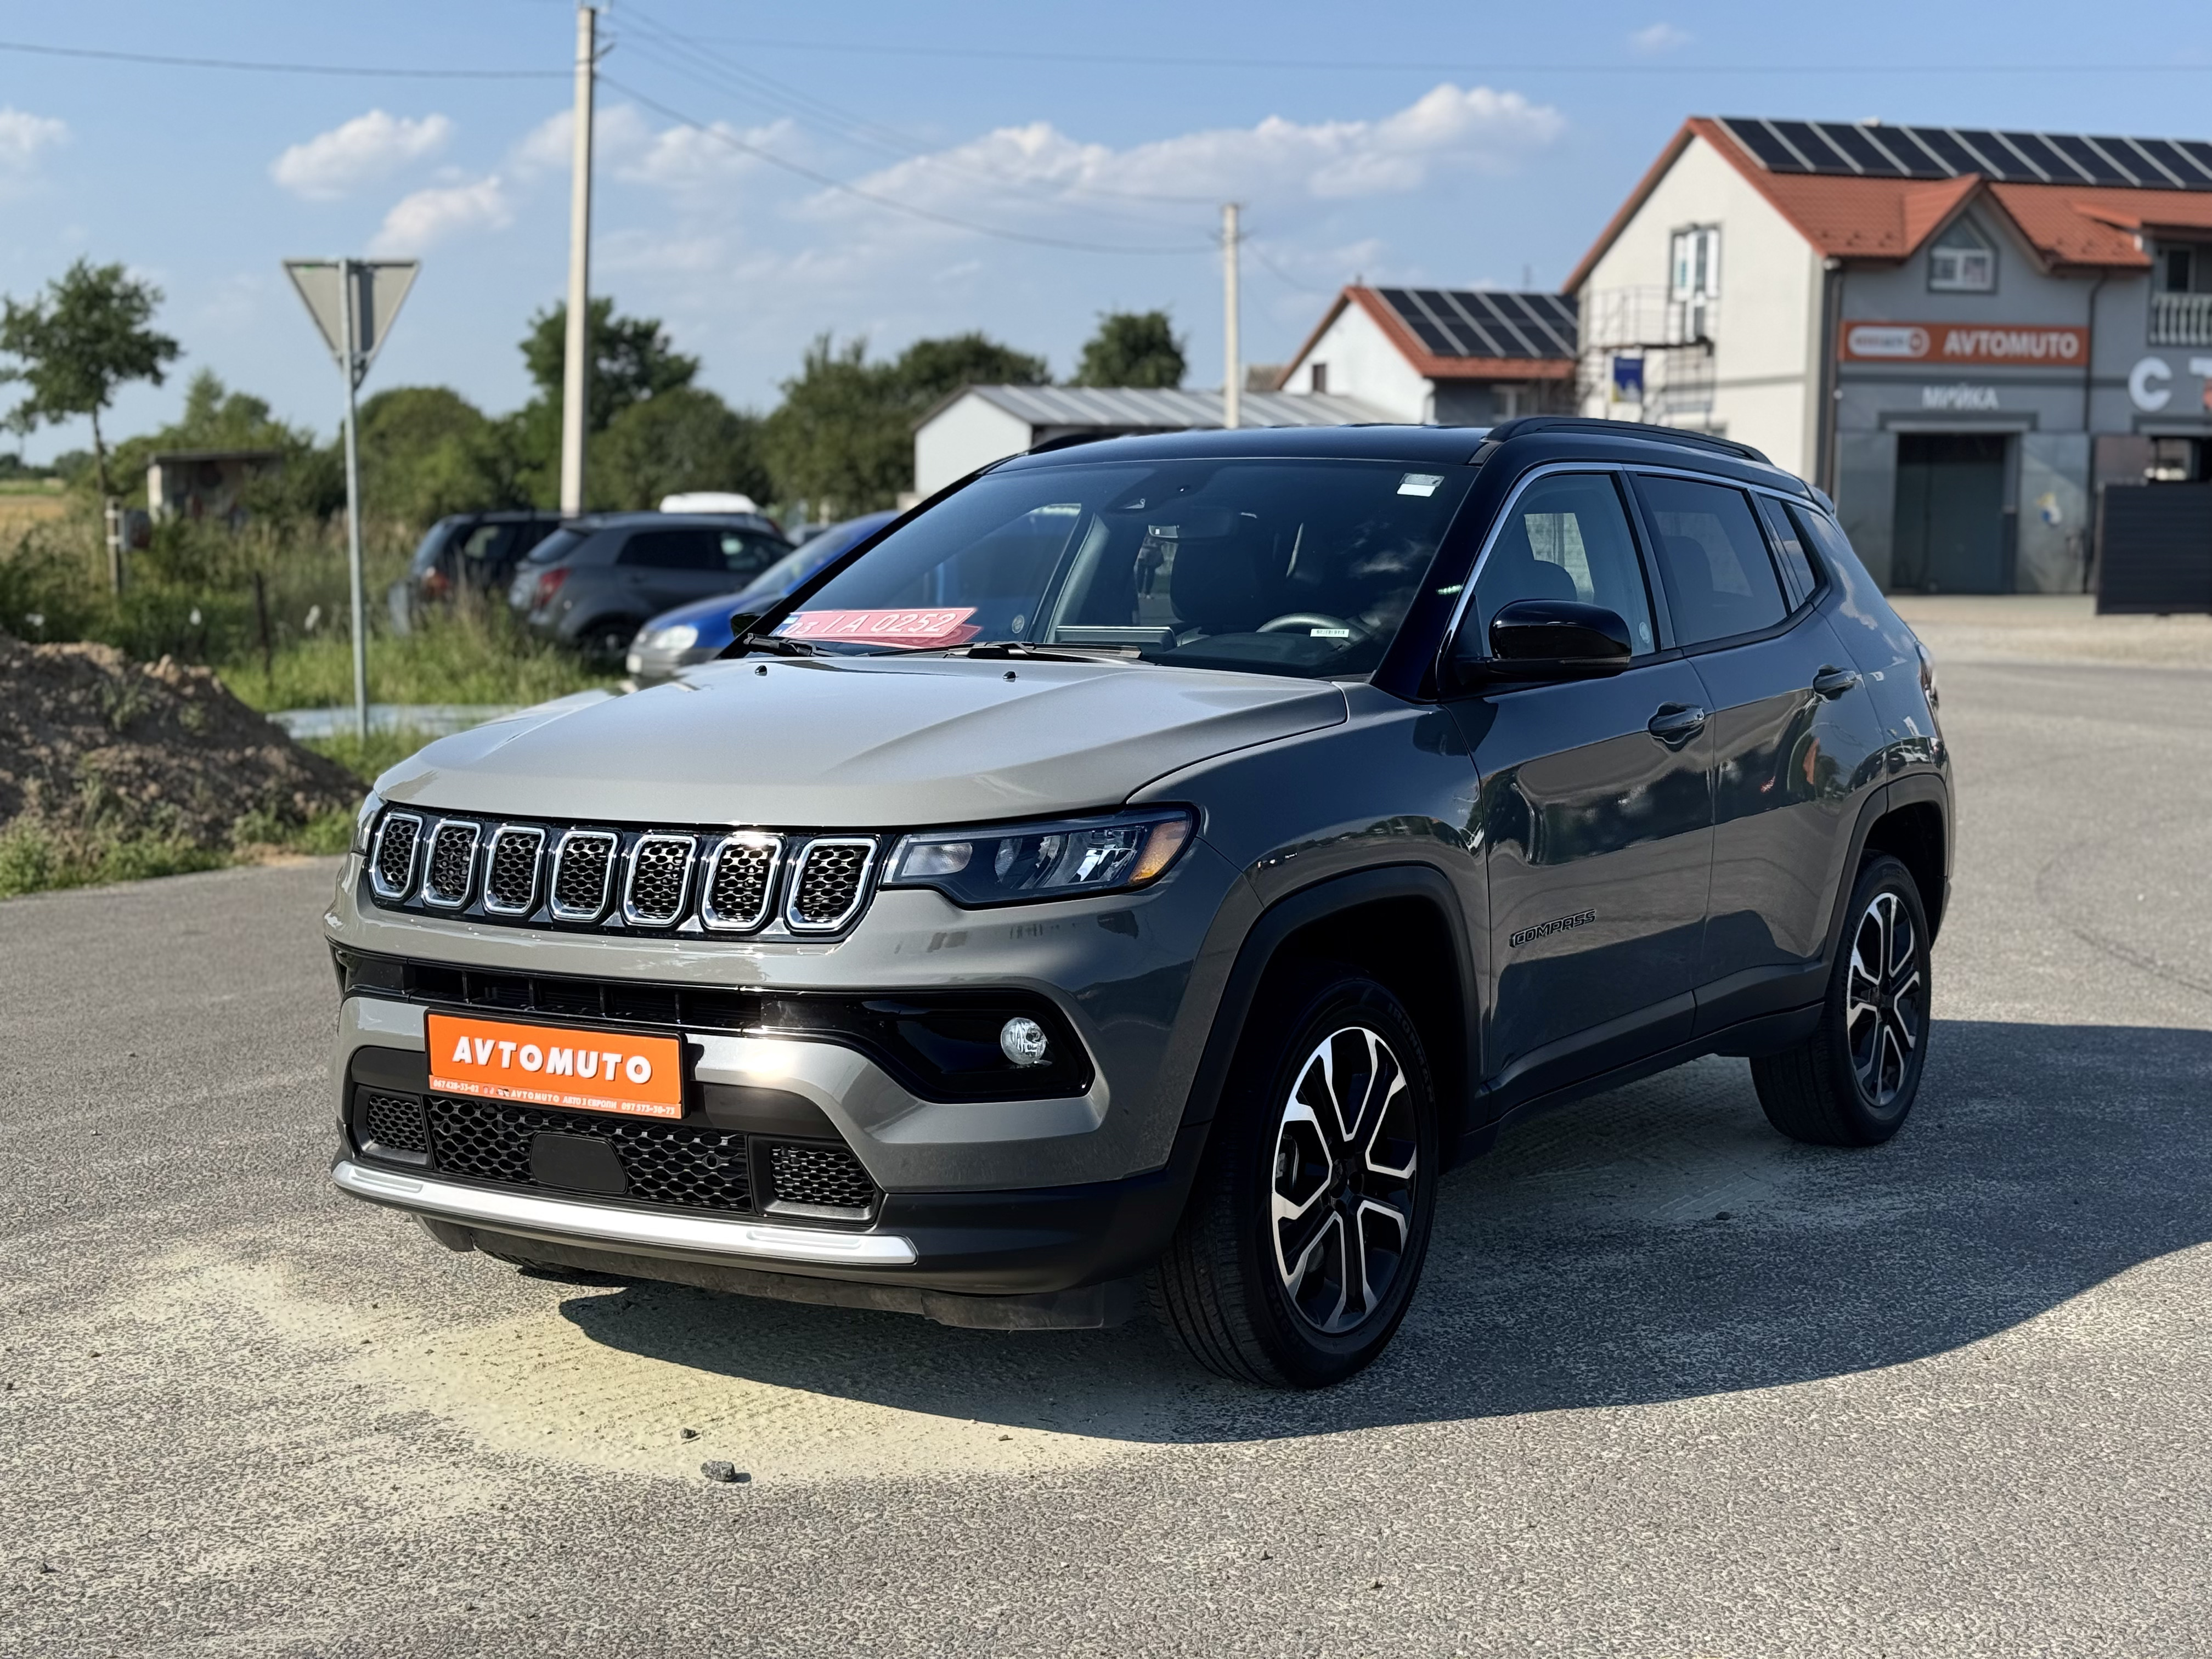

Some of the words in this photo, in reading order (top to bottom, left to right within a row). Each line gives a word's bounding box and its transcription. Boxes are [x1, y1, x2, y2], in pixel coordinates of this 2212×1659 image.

[1943, 329, 2079, 358] AVTOMUTO
[870, 612, 957, 633] 0252
[1513, 909, 1596, 946] COMPASS
[452, 1035, 653, 1085] AVTOMUTO
[1387, 1002, 1434, 1104] IRONMAN
[510, 1090, 560, 1103] AVTOMUTO
